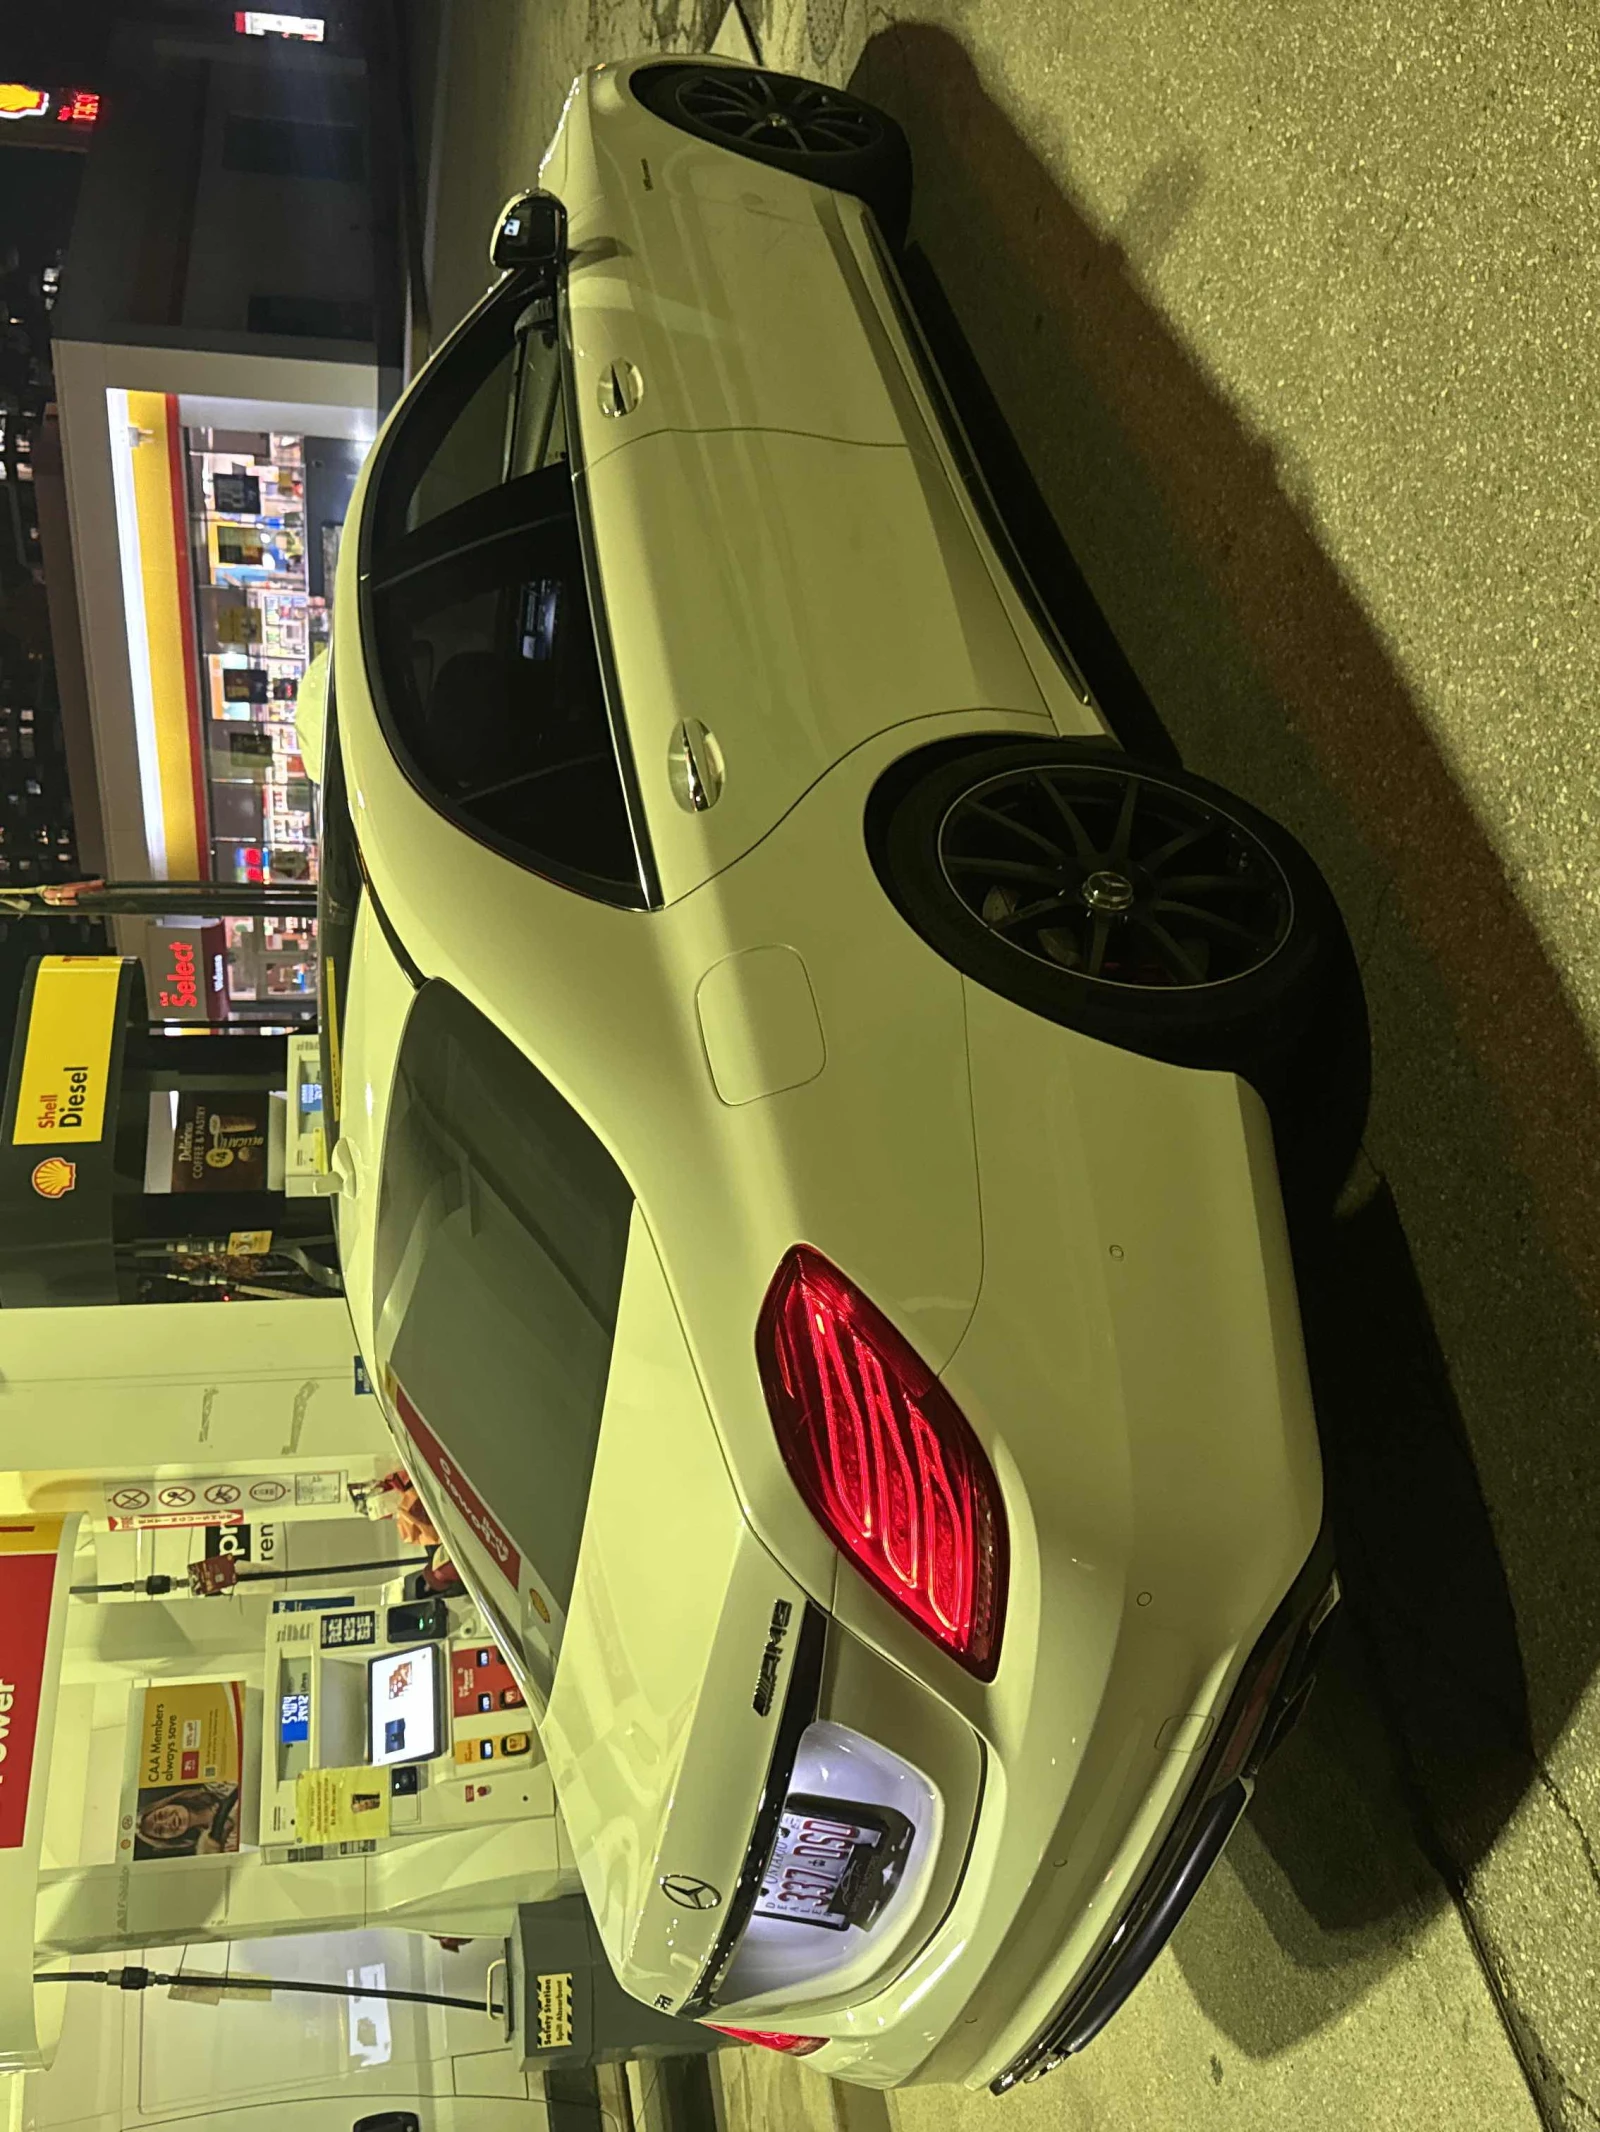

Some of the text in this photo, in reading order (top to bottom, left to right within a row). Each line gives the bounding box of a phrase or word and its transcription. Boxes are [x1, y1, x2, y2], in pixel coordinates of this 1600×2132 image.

[167, 942, 198, 1007] Select
[37, 1094, 58, 1128] Shell
[59, 1066, 89, 1127] Diesel
[196, 1105, 206, 1134] PASTRY
[193, 1146, 204, 1179] COFFEE
[138, 1514, 232, 1526] EXTINGUISHER
[259, 1523, 274, 1561] ren
[0, 1678, 15, 1785] wer
[148, 1704, 164, 1782] CAA Members
[162, 1714, 178, 1781] always save
[777, 1868, 838, 1907] 337
[543, 2015, 553, 2045] Safety
[556, 2024, 564, 2041] Spill
